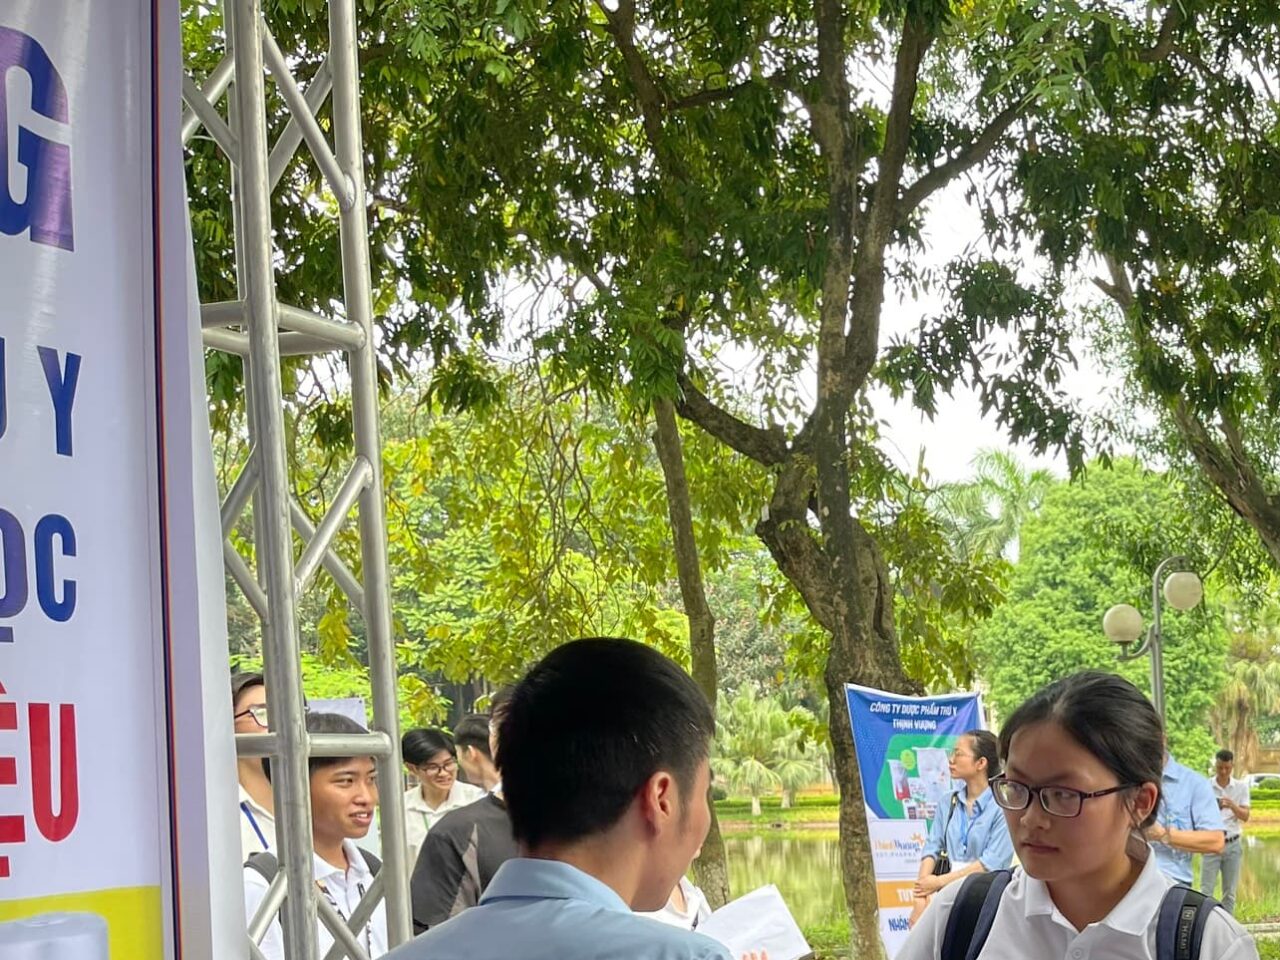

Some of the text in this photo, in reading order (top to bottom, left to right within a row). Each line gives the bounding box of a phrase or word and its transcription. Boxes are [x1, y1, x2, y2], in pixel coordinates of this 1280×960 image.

[870, 702, 890, 713] CÔNG
[891, 704, 901, 714] TY
[901, 704, 919, 716] DƯỢC
[920, 702, 939, 716] PHẨM
[893, 719, 937, 731] THỊNH VƯỢNG
